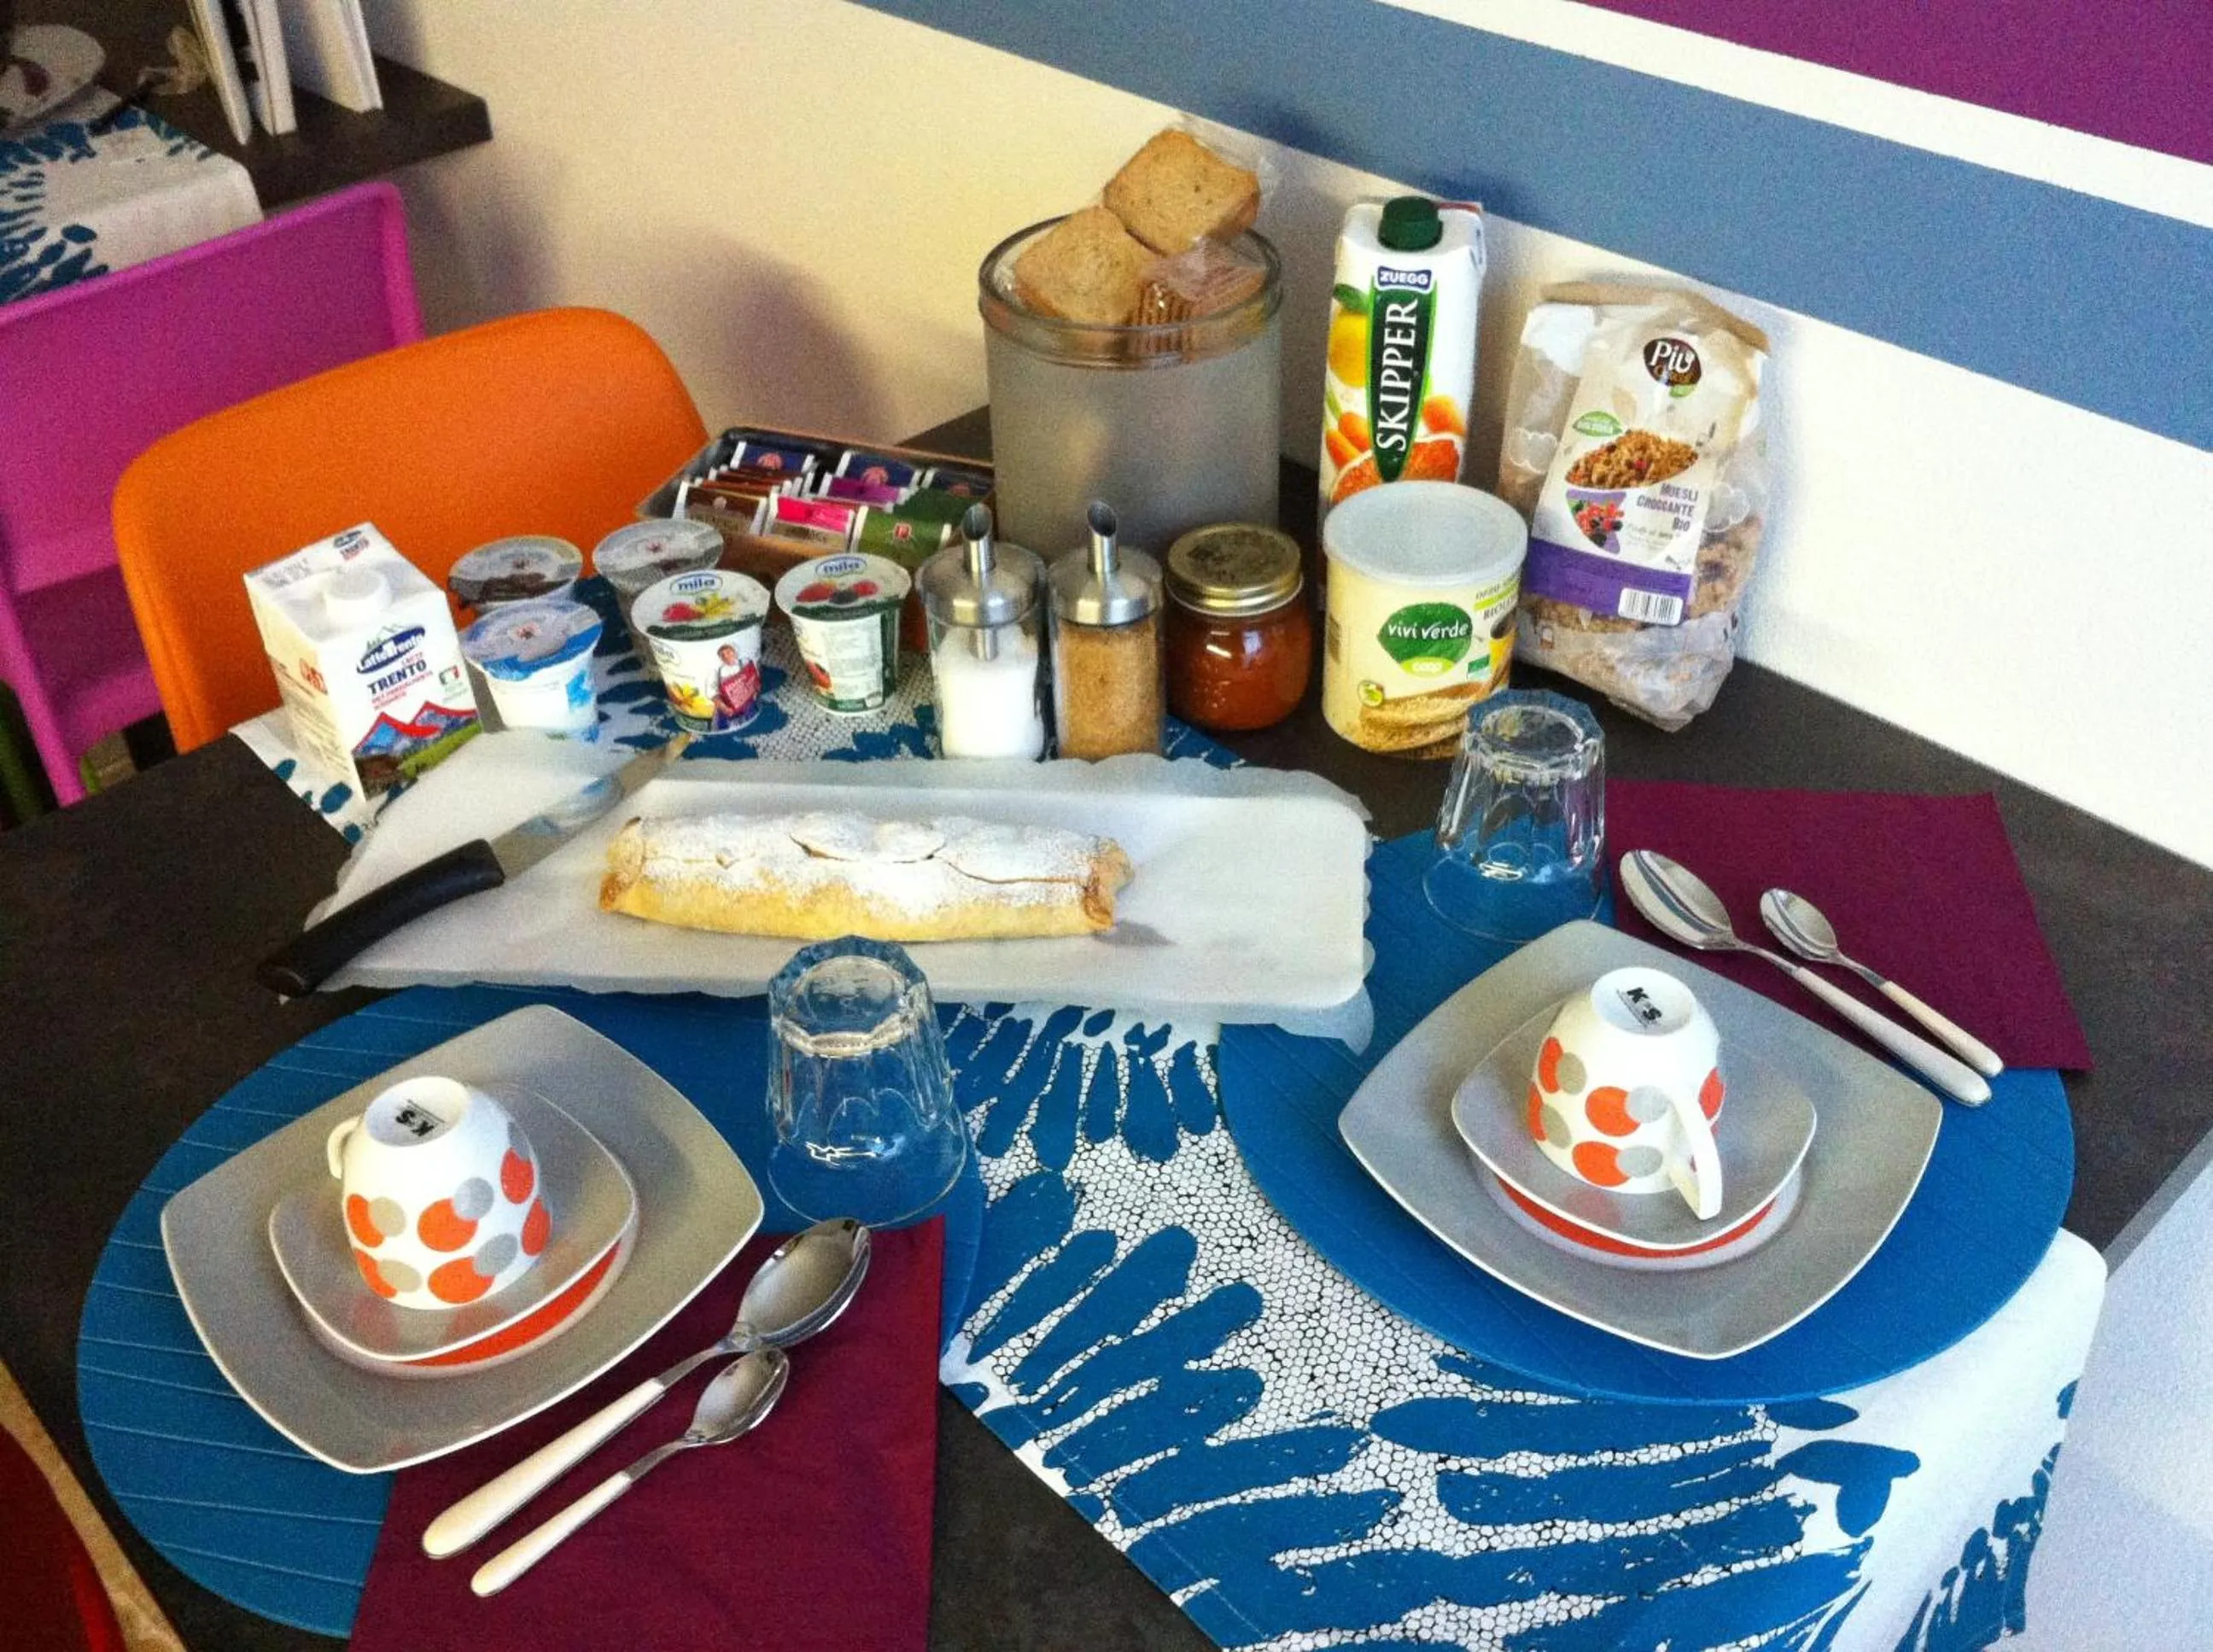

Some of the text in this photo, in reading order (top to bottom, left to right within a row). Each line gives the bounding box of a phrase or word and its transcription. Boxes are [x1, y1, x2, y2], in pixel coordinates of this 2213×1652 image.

[1380, 270, 1428, 286] ZUEGG
[1375, 300, 1418, 452] SKIPPER
[1660, 483, 1699, 502] MUESLI
[824, 561, 861, 574] mila
[677, 577, 715, 591] mila
[1386, 619, 1469, 640] vivi verde
[367, 658, 427, 694] TRENTO
